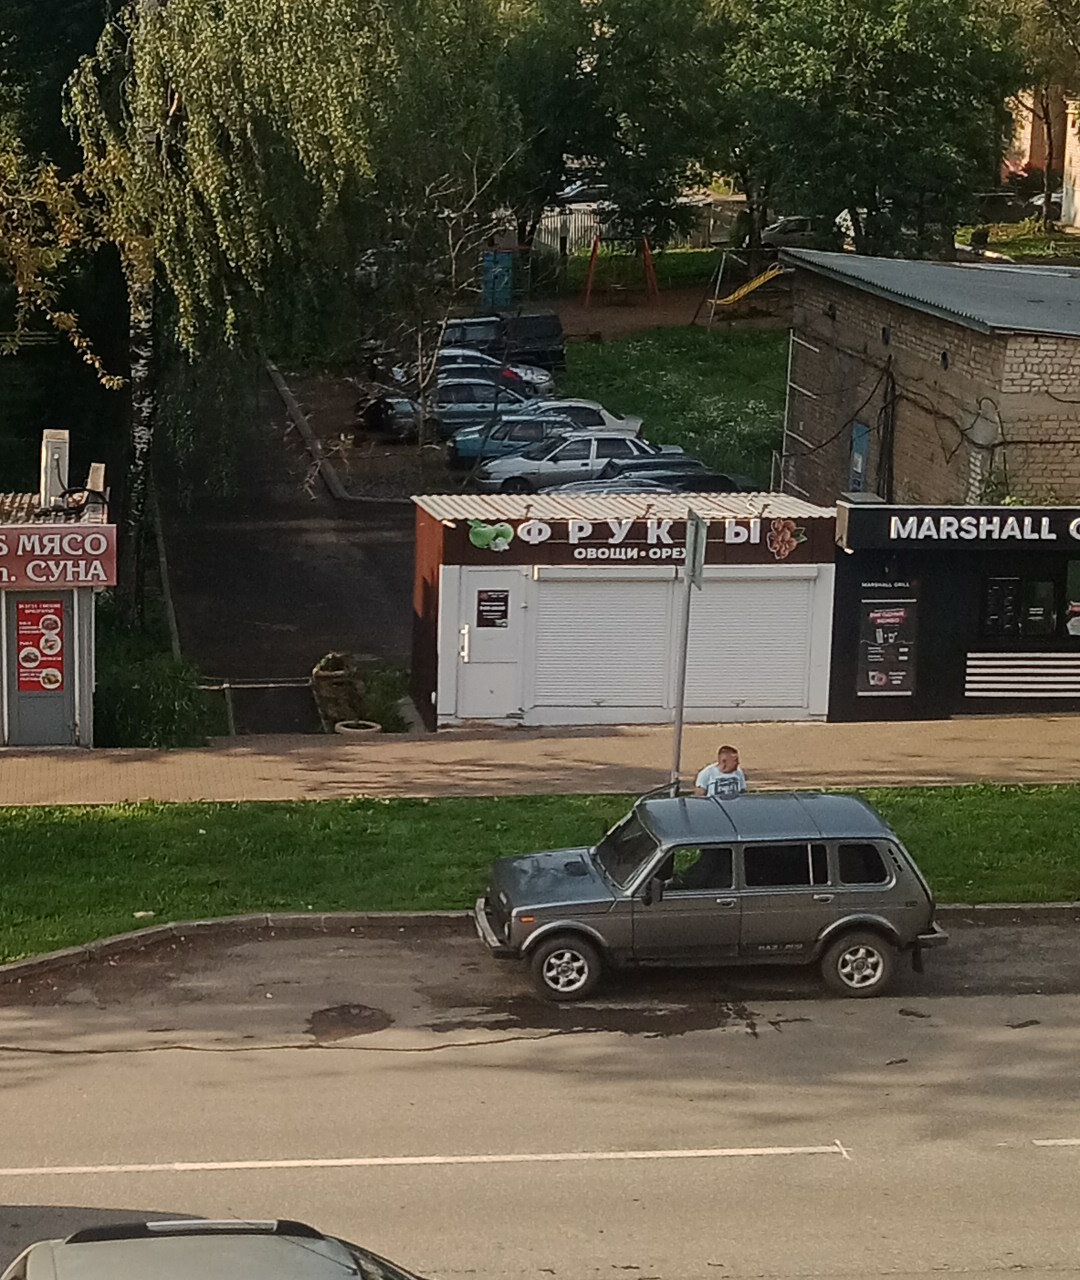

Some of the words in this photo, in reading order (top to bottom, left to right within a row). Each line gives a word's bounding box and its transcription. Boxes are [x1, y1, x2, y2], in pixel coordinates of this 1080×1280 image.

[516, 519, 761, 544] ФРУКЫ
[889, 516, 1058, 540] MARSHALL
[16, 533, 108, 556] МЯСО
[573, 547, 639, 560] ОВОЩИ
[25, 560, 108, 582] СУНА
